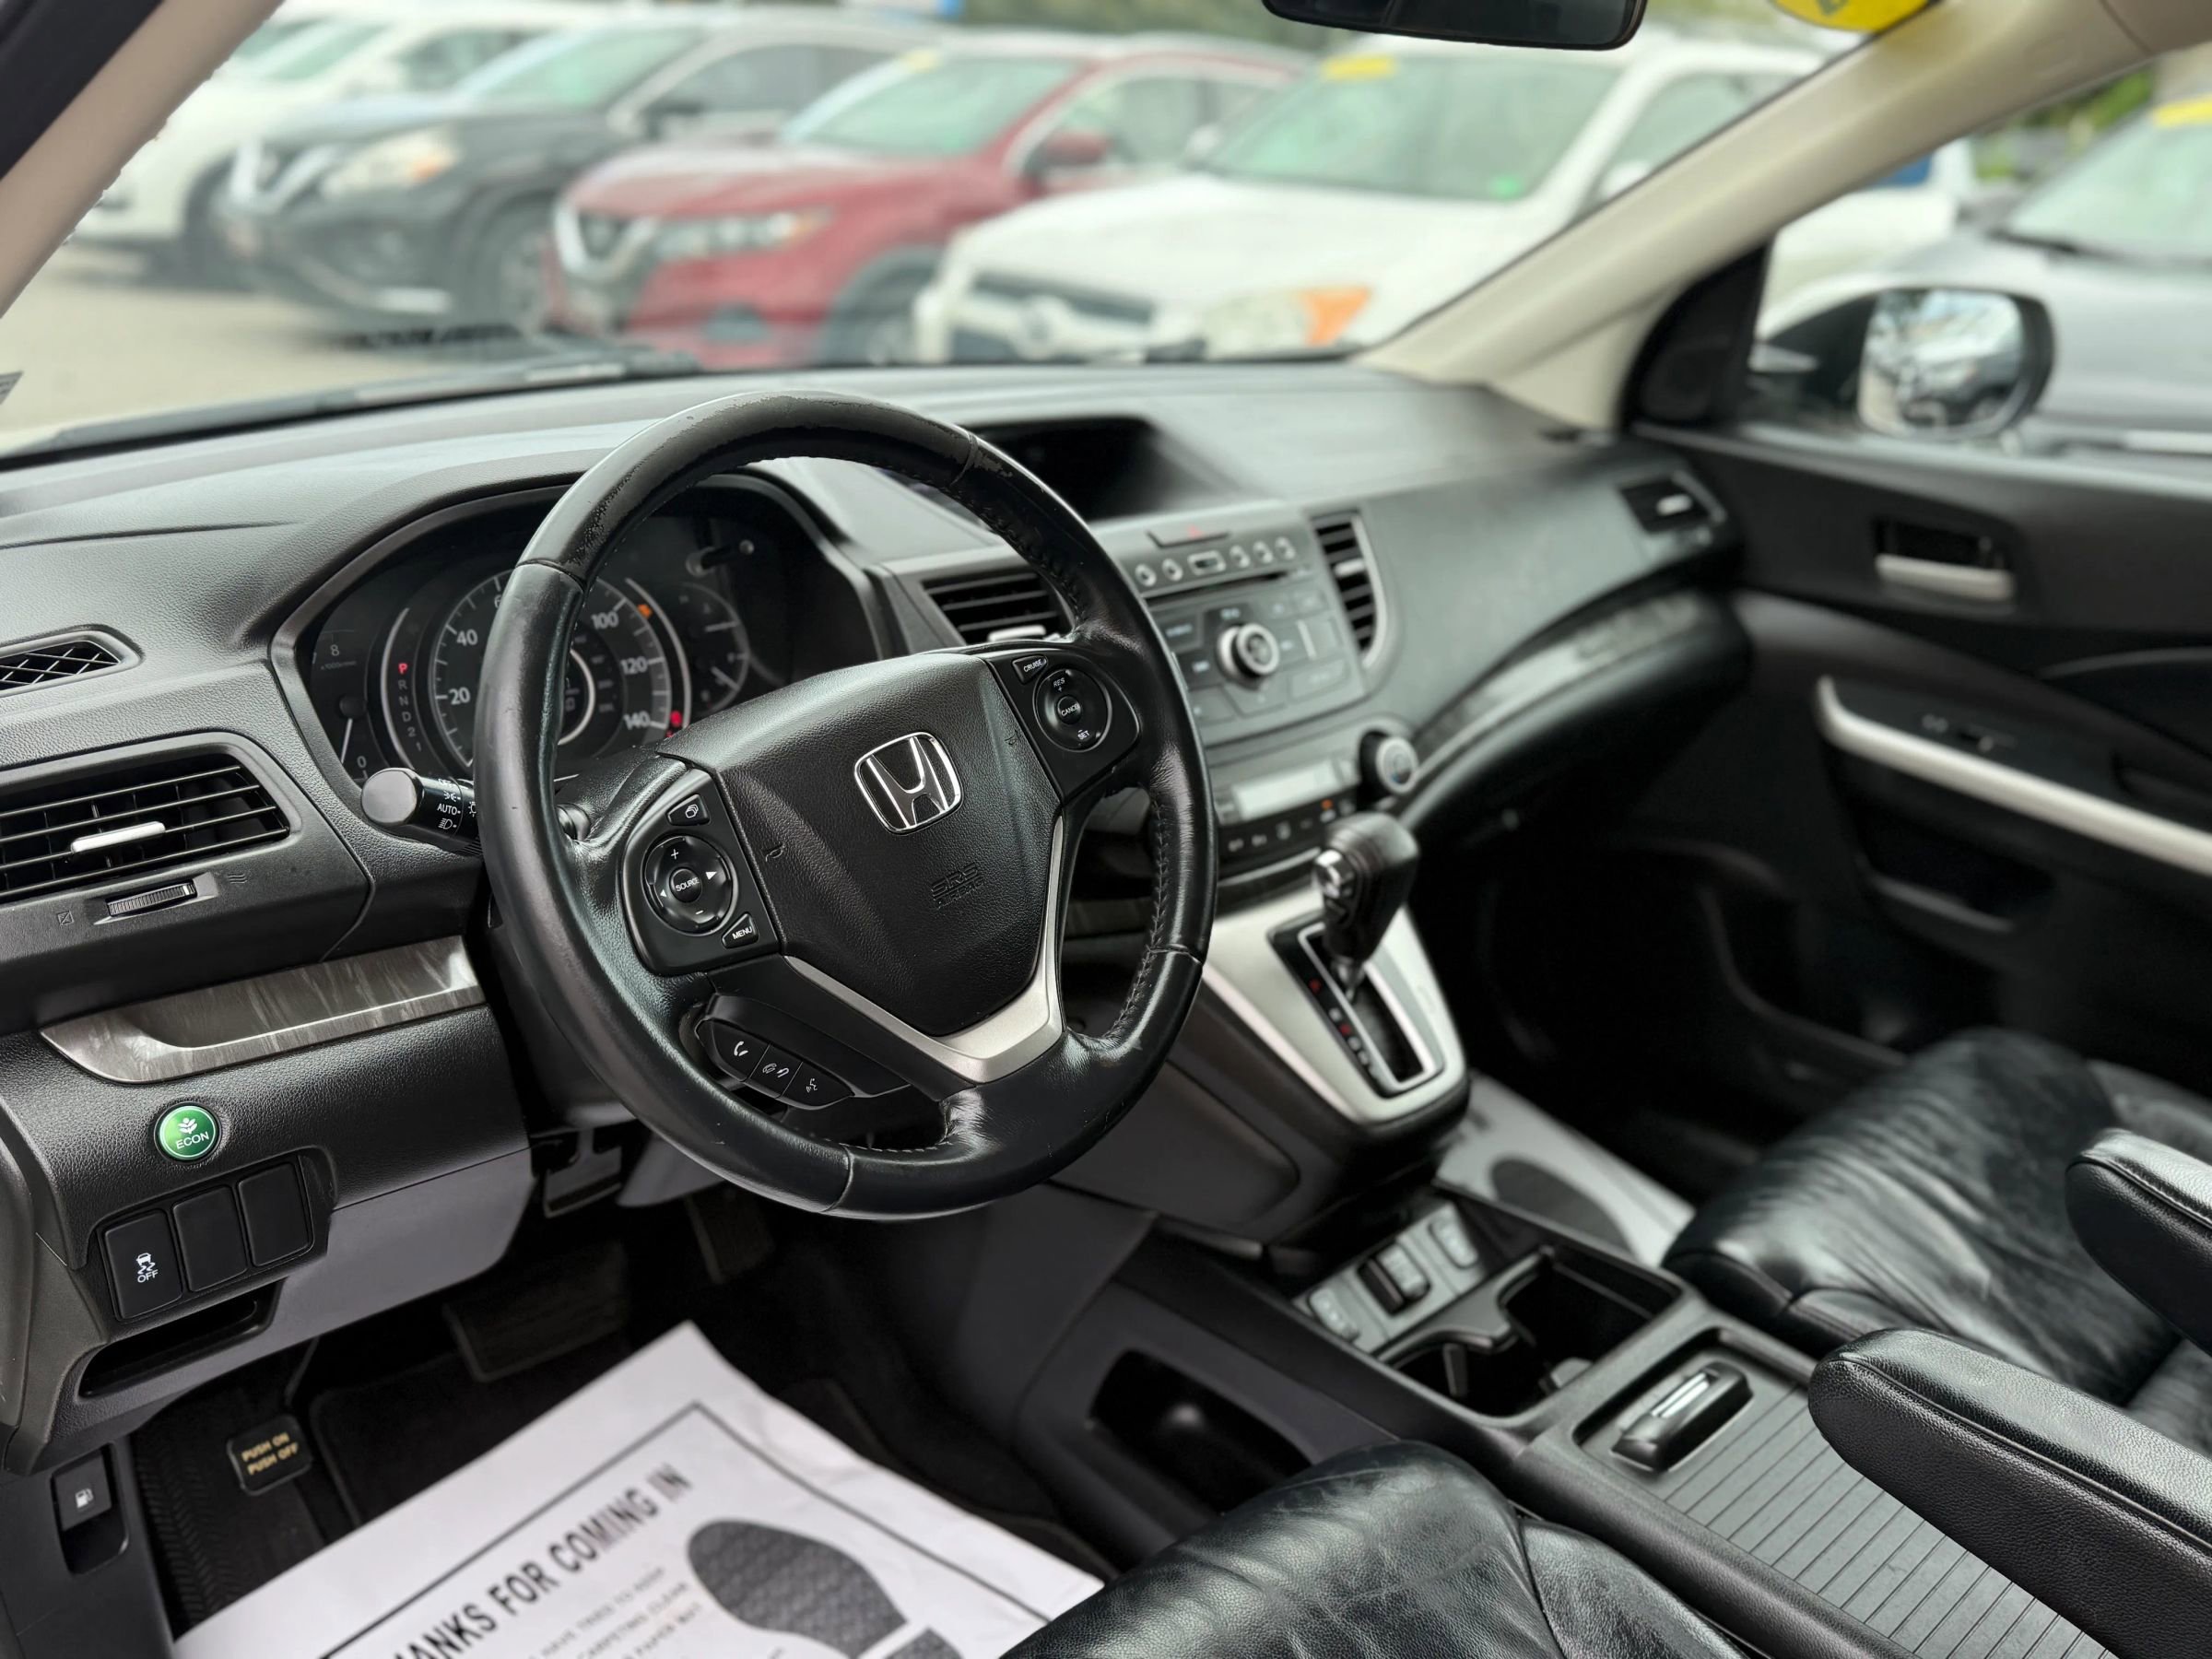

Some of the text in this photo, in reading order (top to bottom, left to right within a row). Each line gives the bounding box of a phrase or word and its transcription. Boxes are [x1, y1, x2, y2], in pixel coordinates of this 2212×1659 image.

[592, 611, 618, 629] 100
[457, 629, 478, 646] 40
[331, 644, 340, 656] 8
[398, 663, 407, 674] P
[620, 656, 647, 675] 120
[1023, 658, 1042, 673] CRUISE
[398, 680, 407, 689] R
[1053, 677, 1065, 688] RES
[399, 696, 408, 705] N
[449, 688, 471, 704] 20
[402, 712, 411, 722] D
[624, 711, 651, 730] 140
[408, 726, 417, 736] 2
[1077, 730, 1090, 740] SET
[358, 756, 367, 768] 0
[437, 803, 458, 816] AUTO
[676, 877, 700, 891] SOURCE
[732, 926, 753, 940] MENU
[175, 1130, 210, 1150] ECON
[137, 1269, 159, 1284] OFF
[241, 1432, 290, 1462] PUSH ON
[247, 1441, 299, 1475] PUSH OFF
[394, 1462, 693, 1659] ANKS FOR COMING IN
